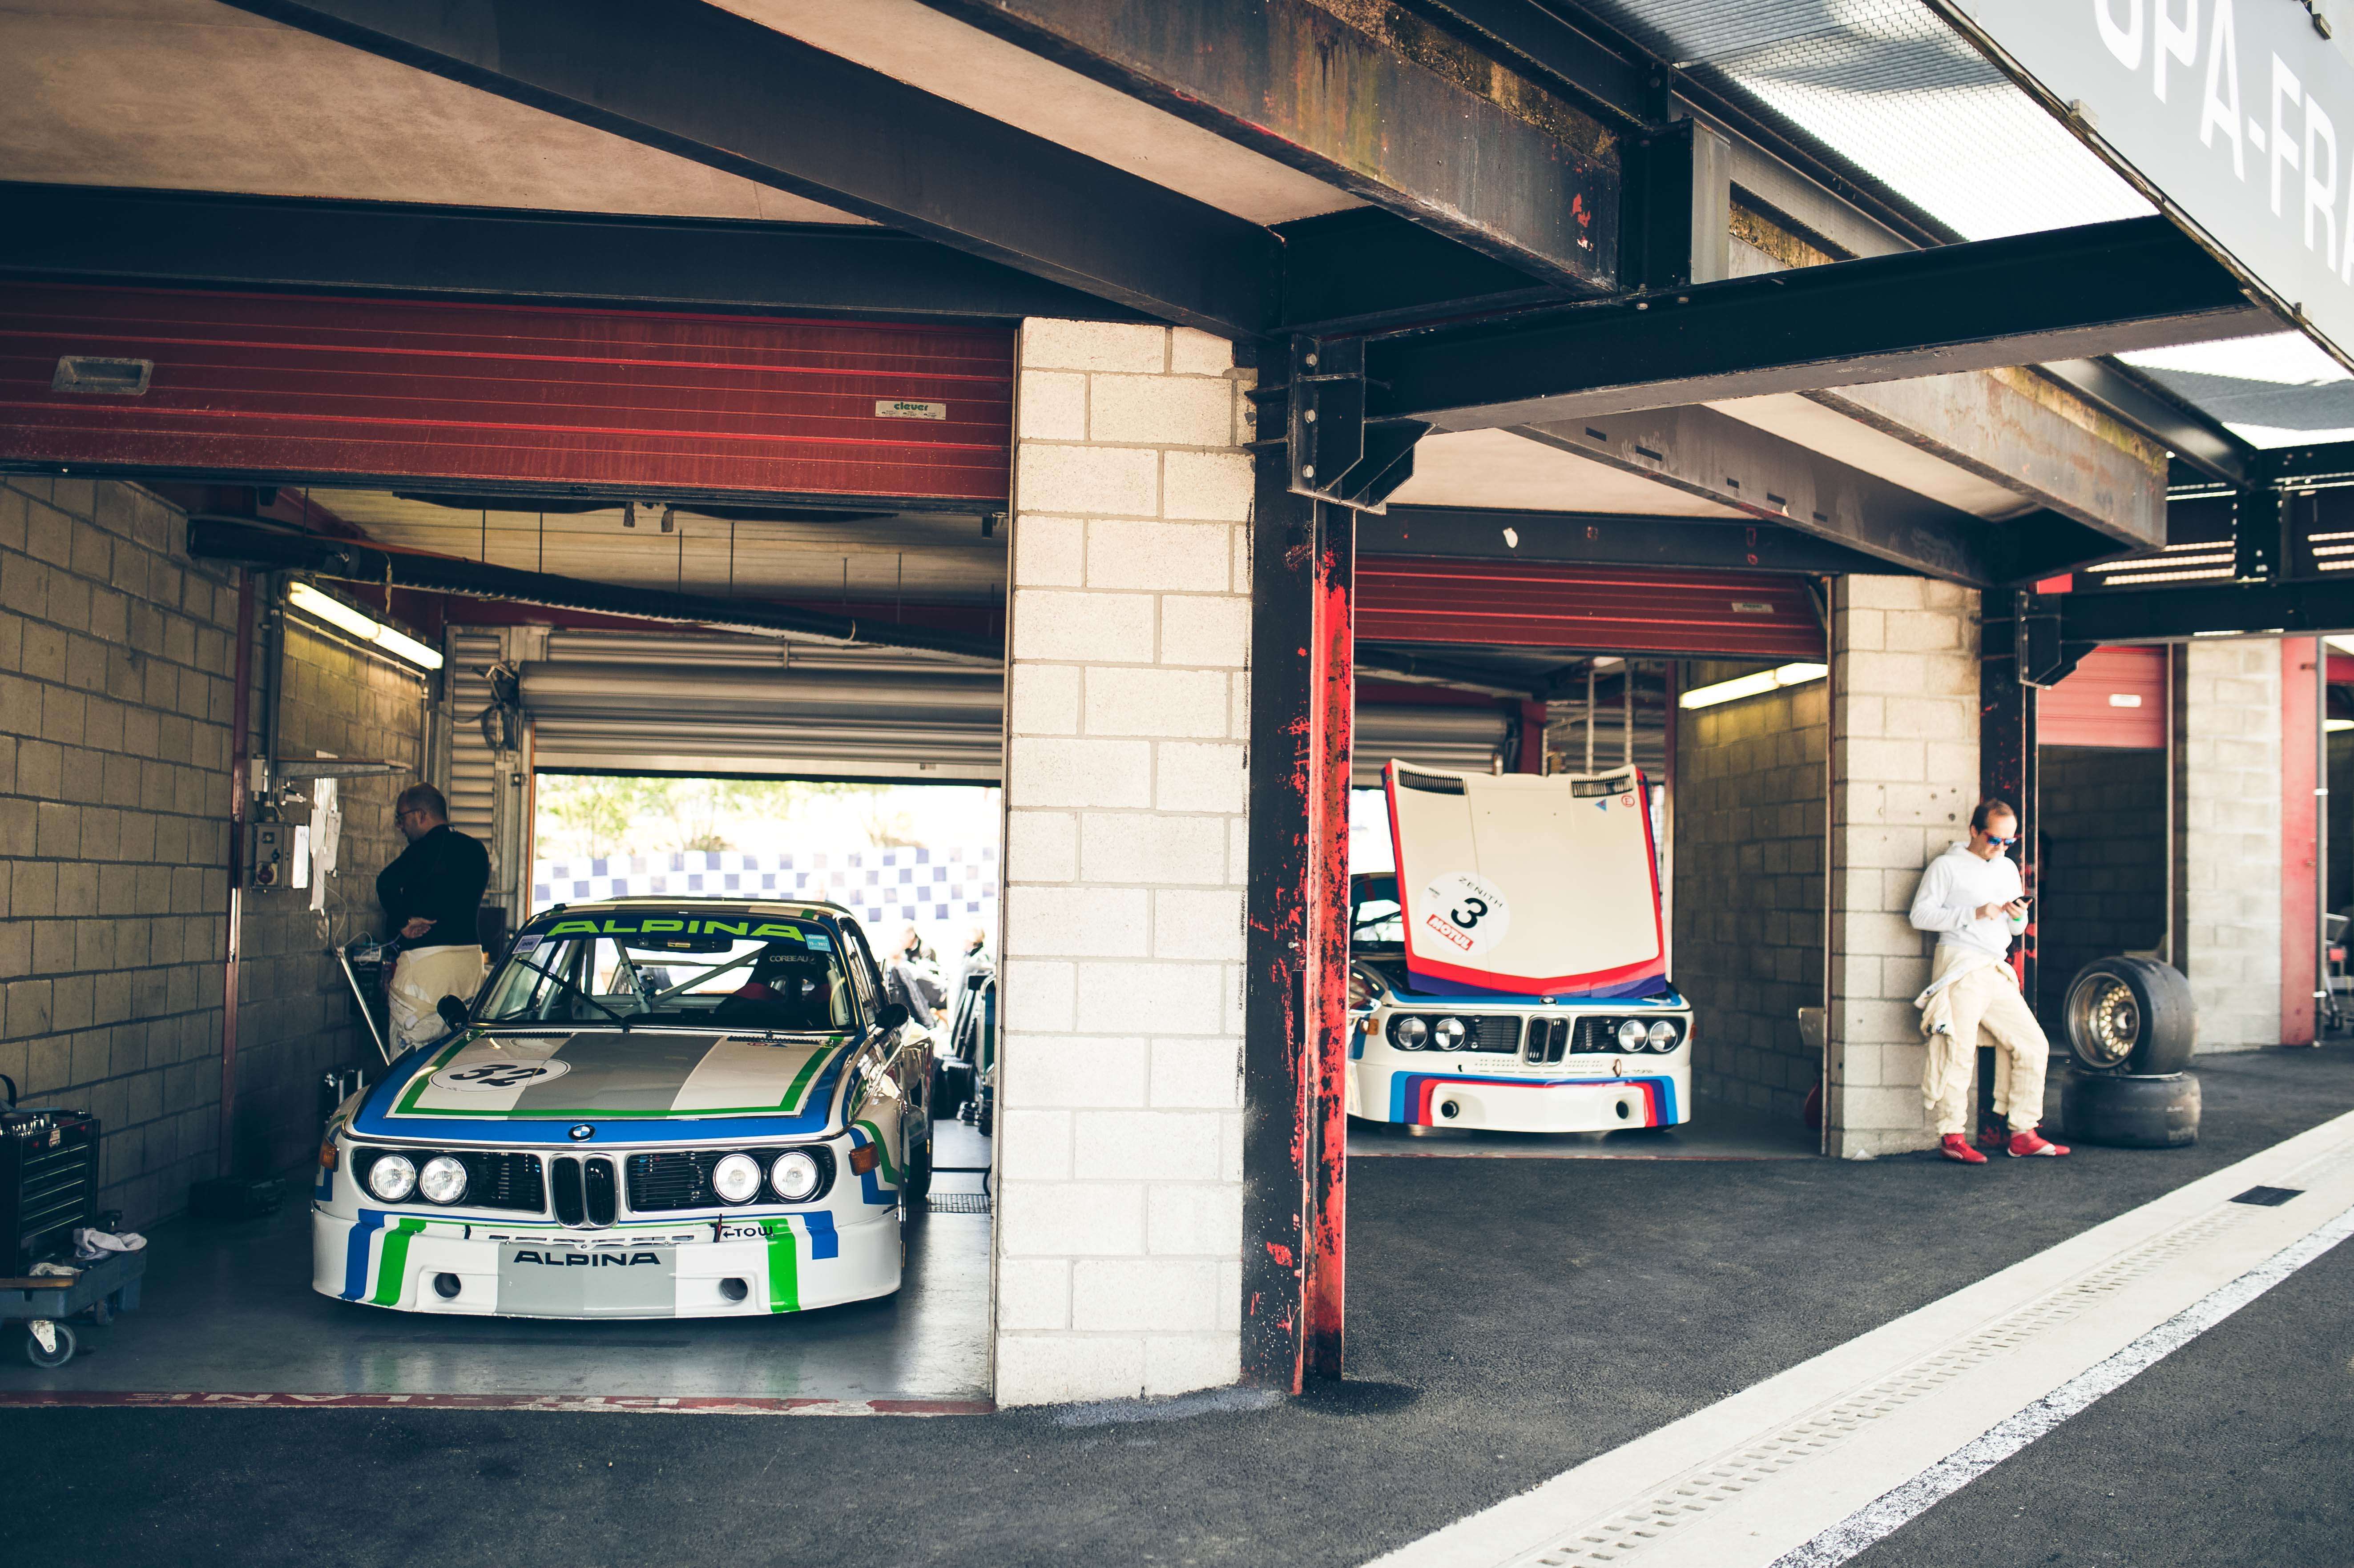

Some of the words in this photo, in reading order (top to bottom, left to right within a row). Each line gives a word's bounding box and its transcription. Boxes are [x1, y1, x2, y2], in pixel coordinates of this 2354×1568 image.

[894, 402, 928, 411] clever
[1459, 876, 1503, 908] ZENITH
[1451, 897, 1488, 929] 3
[545, 920, 805, 942] ALPINA
[1428, 917, 1471, 950] MOTUL
[449, 1064, 548, 1086] 32
[734, 1226, 773, 1237] TOW
[513, 1250, 661, 1266] ALPINA
